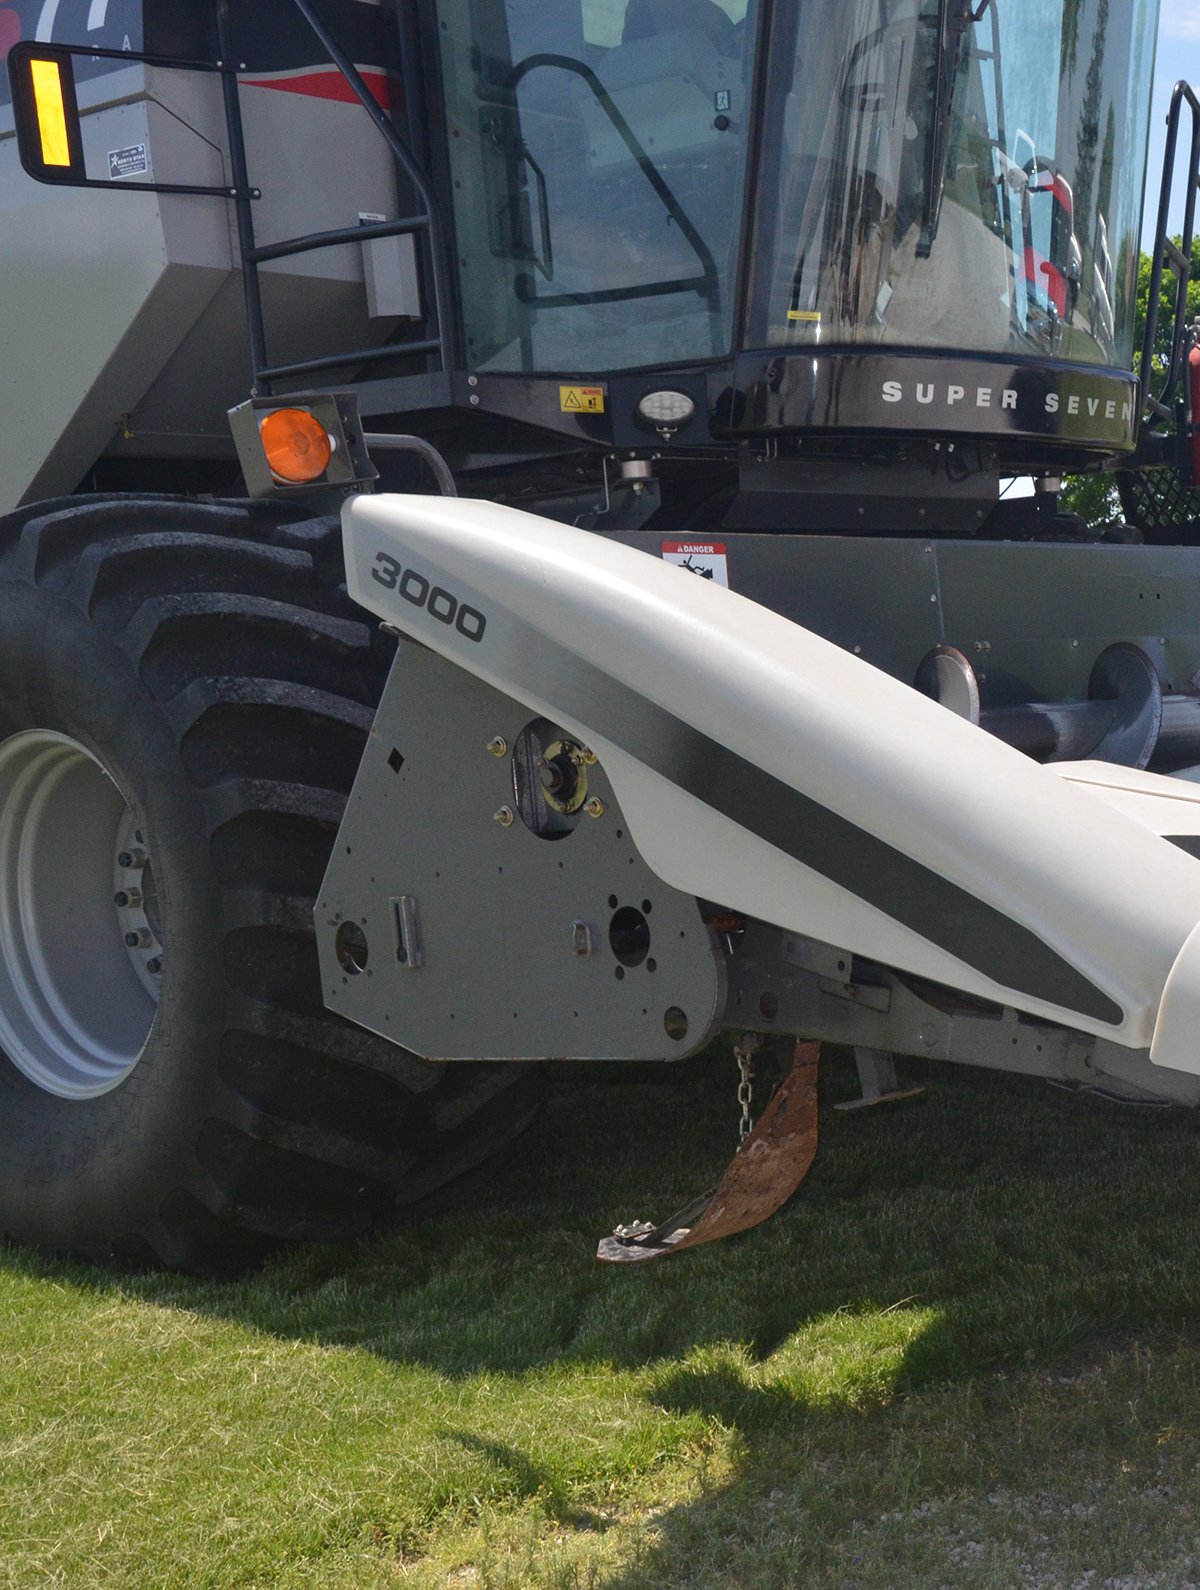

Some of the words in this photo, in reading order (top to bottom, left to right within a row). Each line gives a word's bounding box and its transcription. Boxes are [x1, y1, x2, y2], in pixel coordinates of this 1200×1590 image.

[882, 381, 1018, 409] SUPER
[1045, 393, 1132, 420] SEVEN
[683, 545, 714, 554] DANGER
[371, 551, 487, 643] 3000
